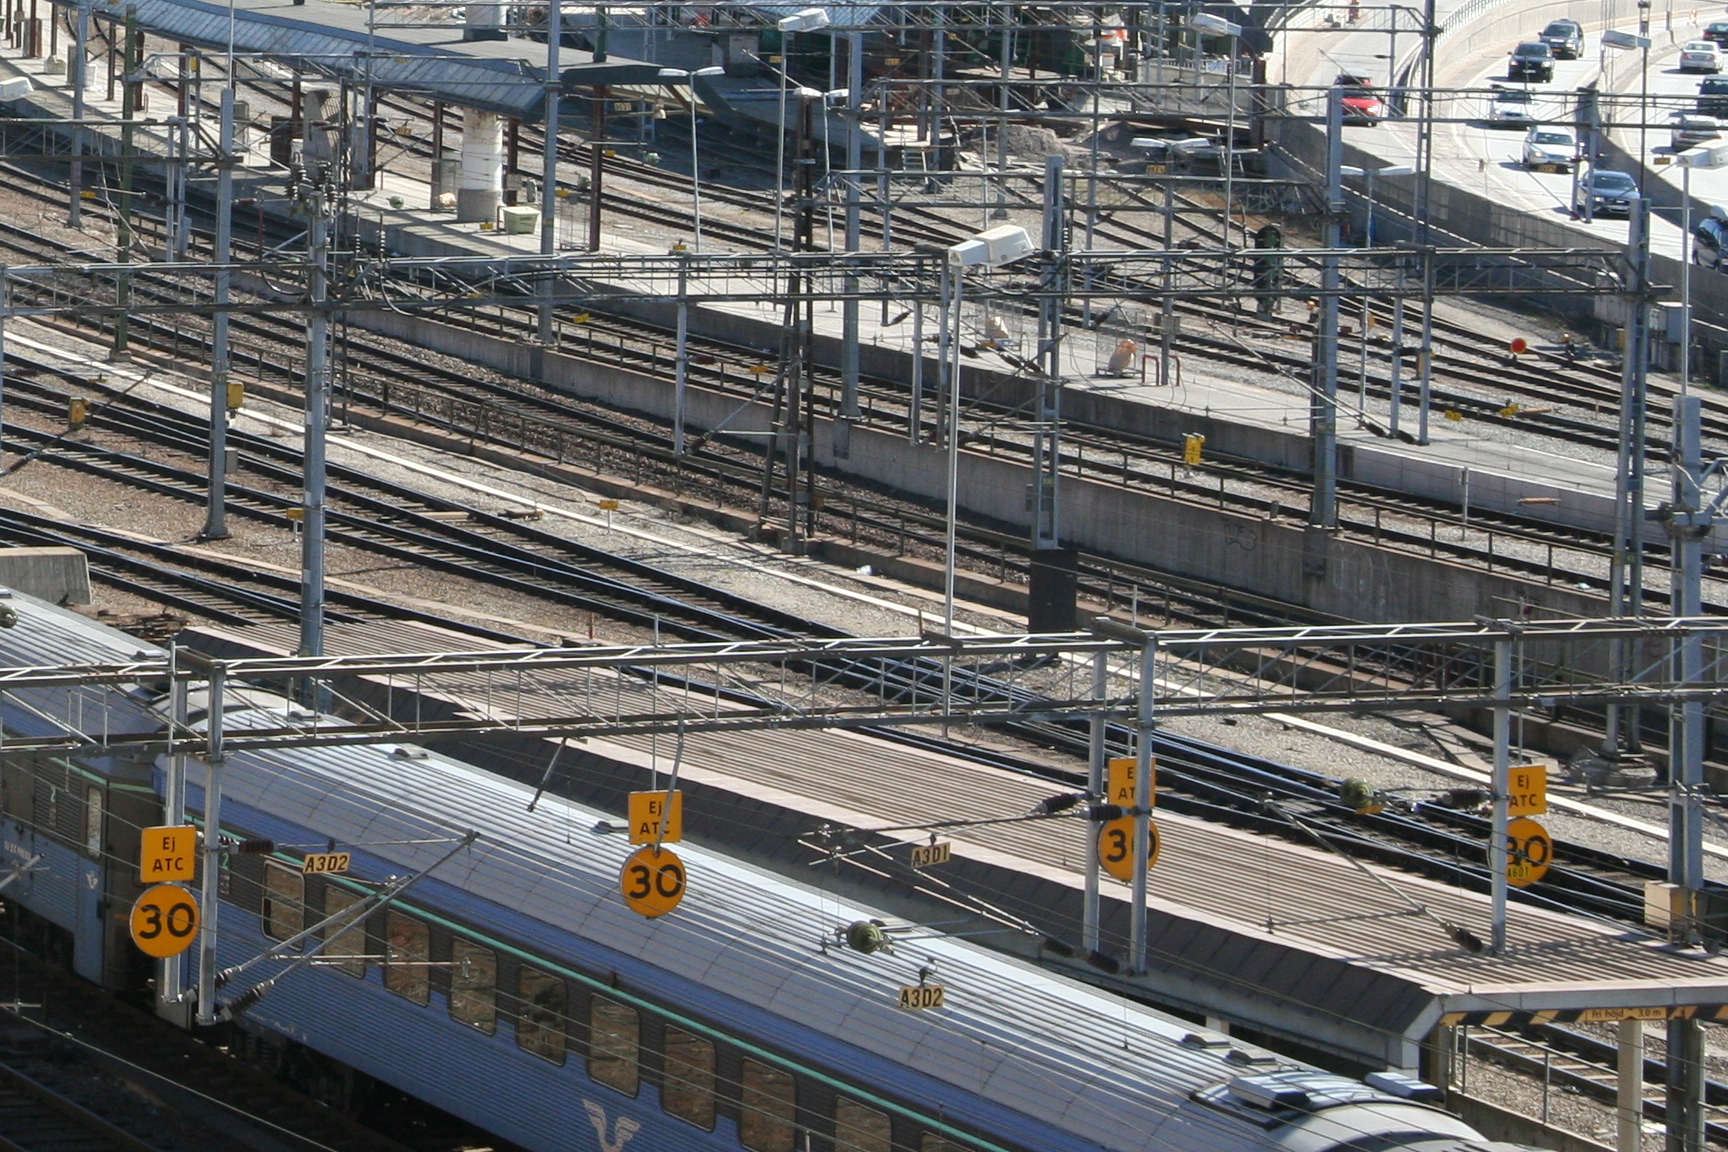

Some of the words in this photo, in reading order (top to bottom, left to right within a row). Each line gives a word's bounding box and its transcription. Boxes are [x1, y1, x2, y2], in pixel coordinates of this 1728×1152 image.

[1518, 773, 1530, 788] Ej
[1118, 788, 1136, 800] AT
[1509, 793, 1536, 807] ATC
[649, 801, 663, 817] Ej
[162, 837, 176, 853] Ej
[152, 857, 184, 871] ATC
[628, 864, 681, 899] 30
[139, 902, 195, 938] 30
